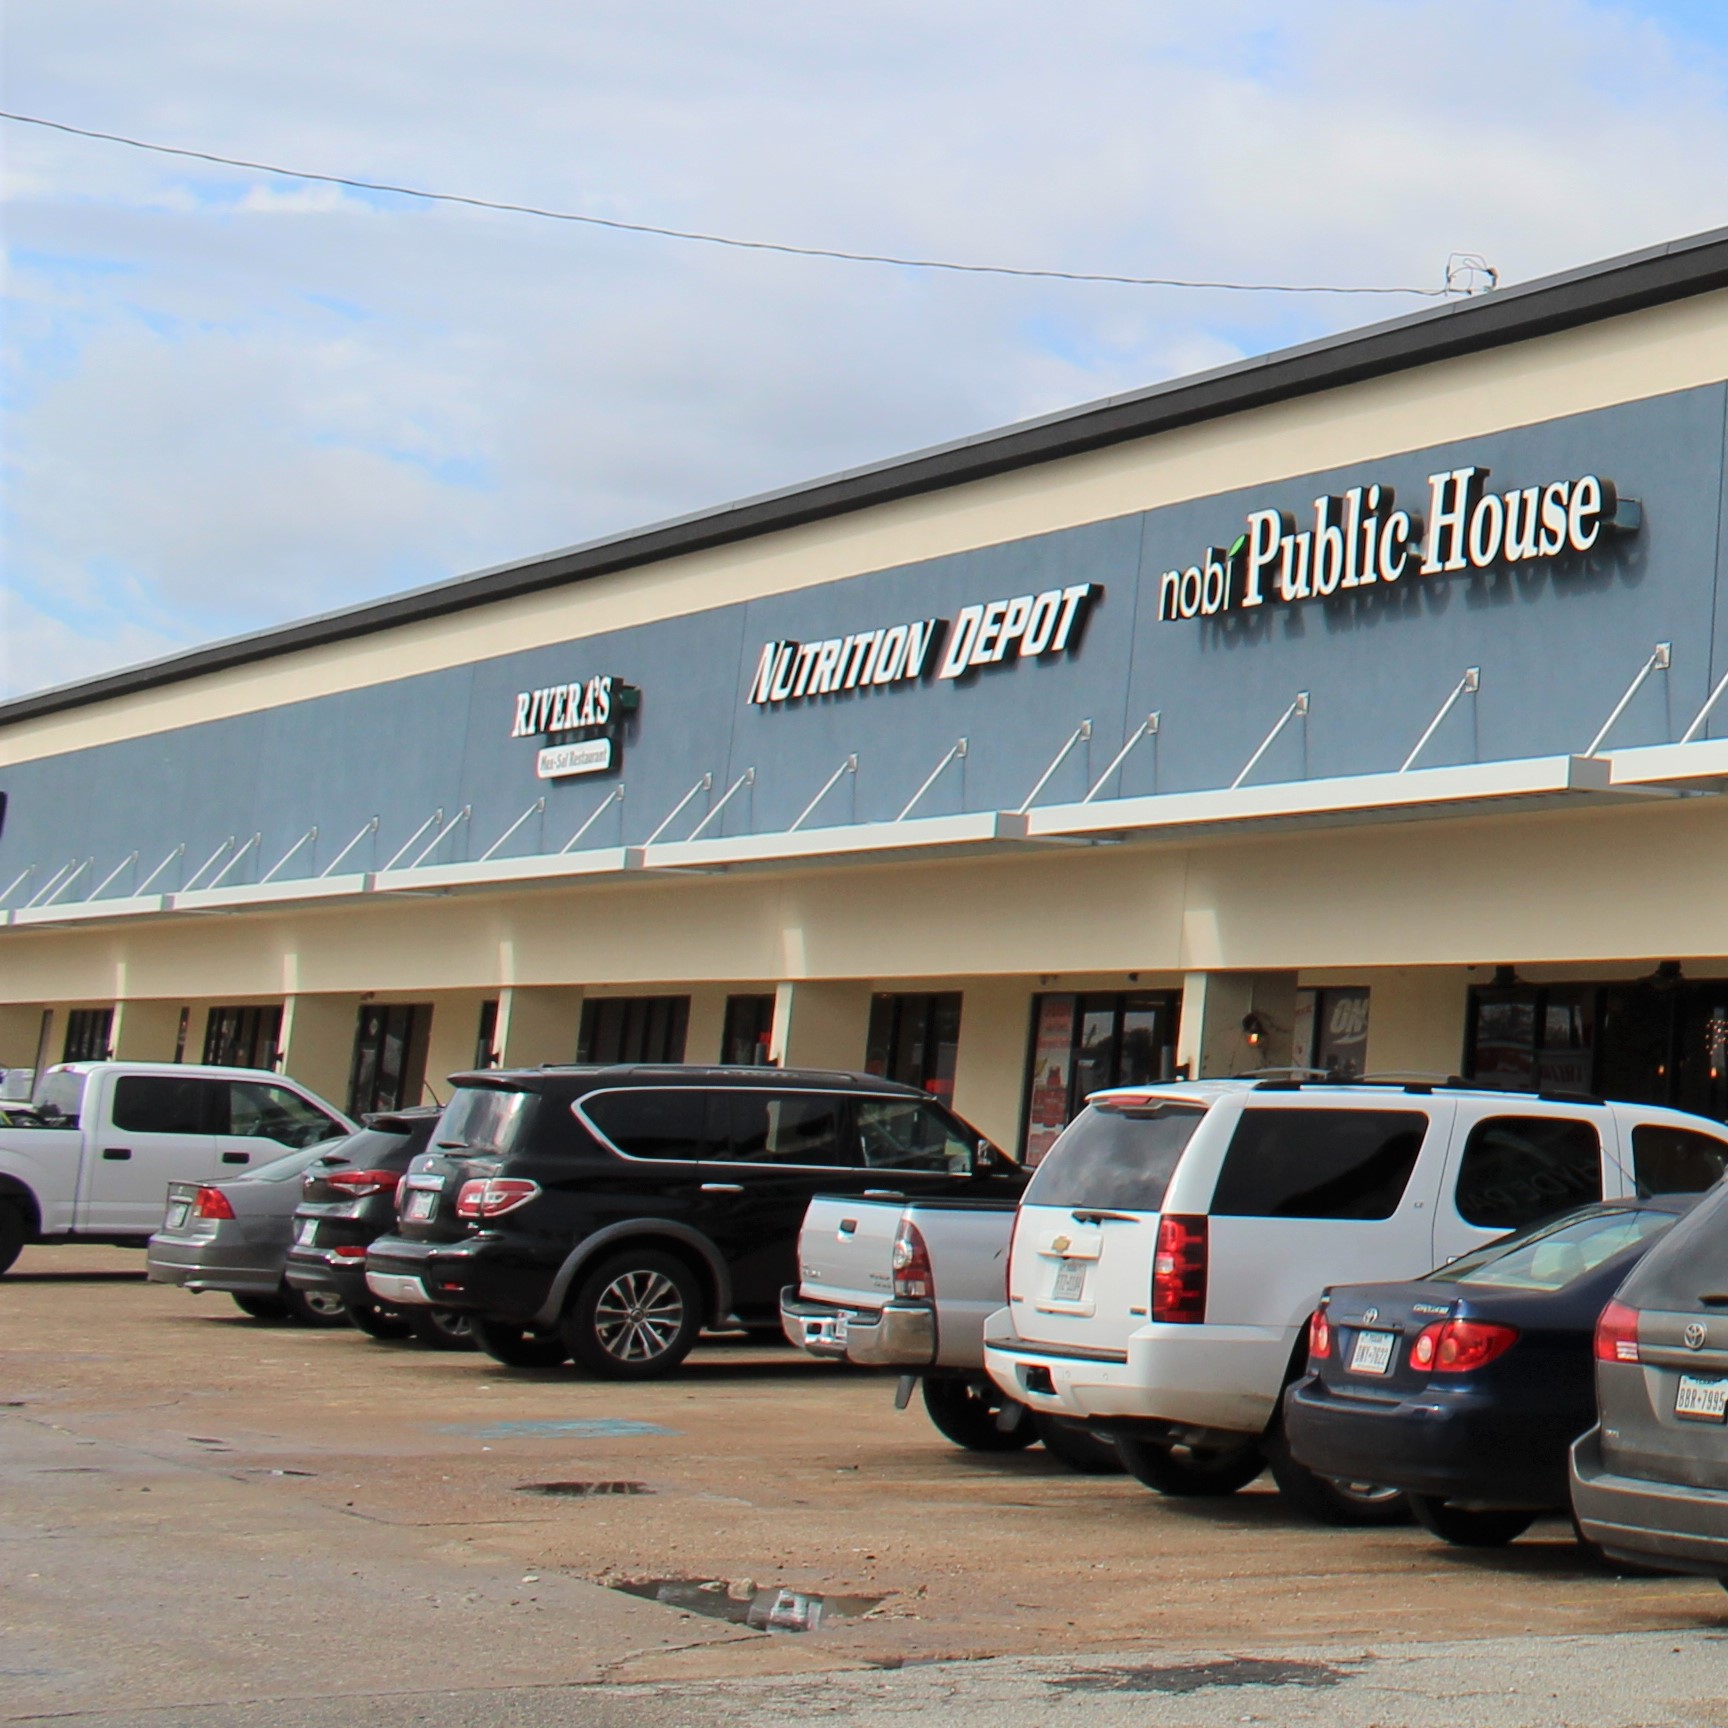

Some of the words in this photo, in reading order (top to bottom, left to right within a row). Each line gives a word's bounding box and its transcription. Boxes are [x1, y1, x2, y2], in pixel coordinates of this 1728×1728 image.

[1158, 534, 1246, 621] nobi
[1242, 483, 1410, 607] Public
[1421, 467, 1602, 575] House
[747, 618, 938, 704] NUTRITION
[938, 583, 1092, 679] DEPOT
[511, 674, 611, 737] RIVERA'S
[569, 747, 607, 766] Restaurant
